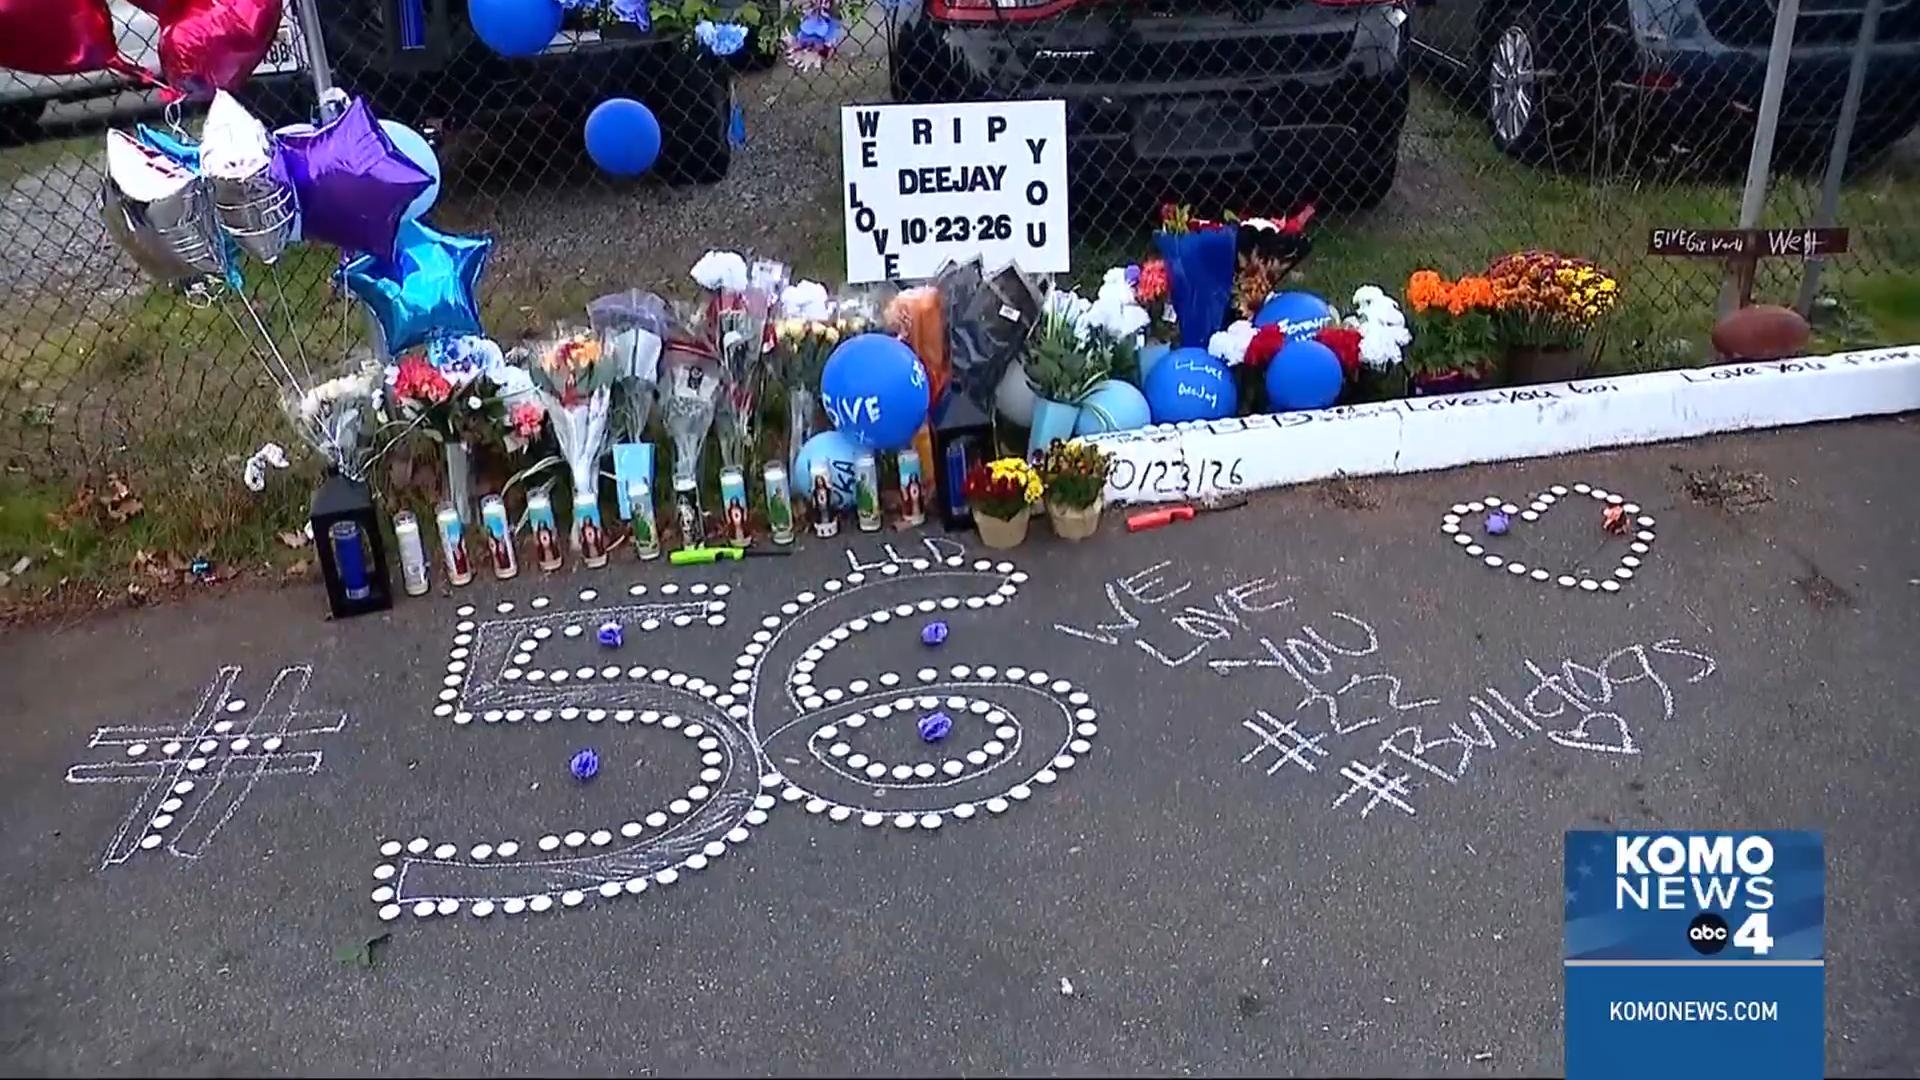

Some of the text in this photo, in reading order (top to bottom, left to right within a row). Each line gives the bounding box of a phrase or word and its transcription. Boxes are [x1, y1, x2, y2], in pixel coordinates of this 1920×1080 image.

[856, 111, 880, 168] WE
[899, 165, 1008, 195] DEEJAY
[850, 182, 900, 279] LOVE
[1026, 138, 1049, 248] YOU
[1054, 560, 1192, 646] WE
[1134, 577, 1297, 668] LOVE
